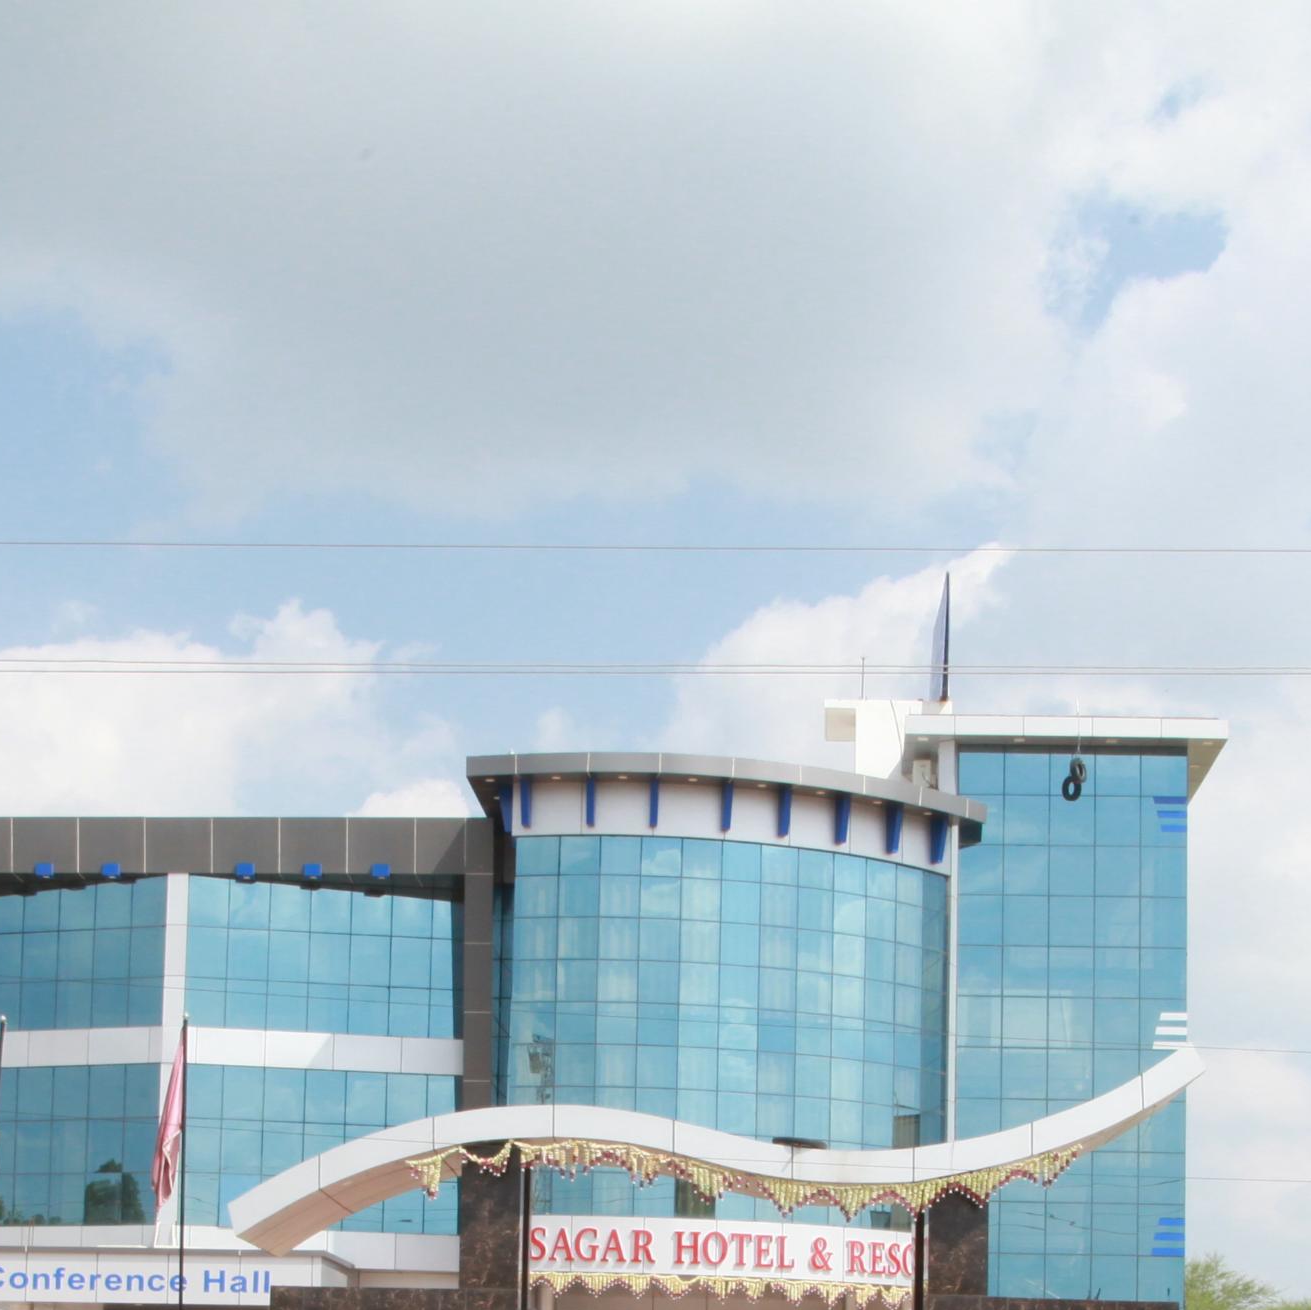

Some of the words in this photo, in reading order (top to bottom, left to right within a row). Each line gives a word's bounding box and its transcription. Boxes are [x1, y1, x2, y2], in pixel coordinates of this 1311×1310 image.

[530, 1227, 655, 1264] SAGAR
[674, 1231, 795, 1269] HOTEL
[810, 1237, 833, 1271] &
[203, 1270, 270, 1293] Hall
